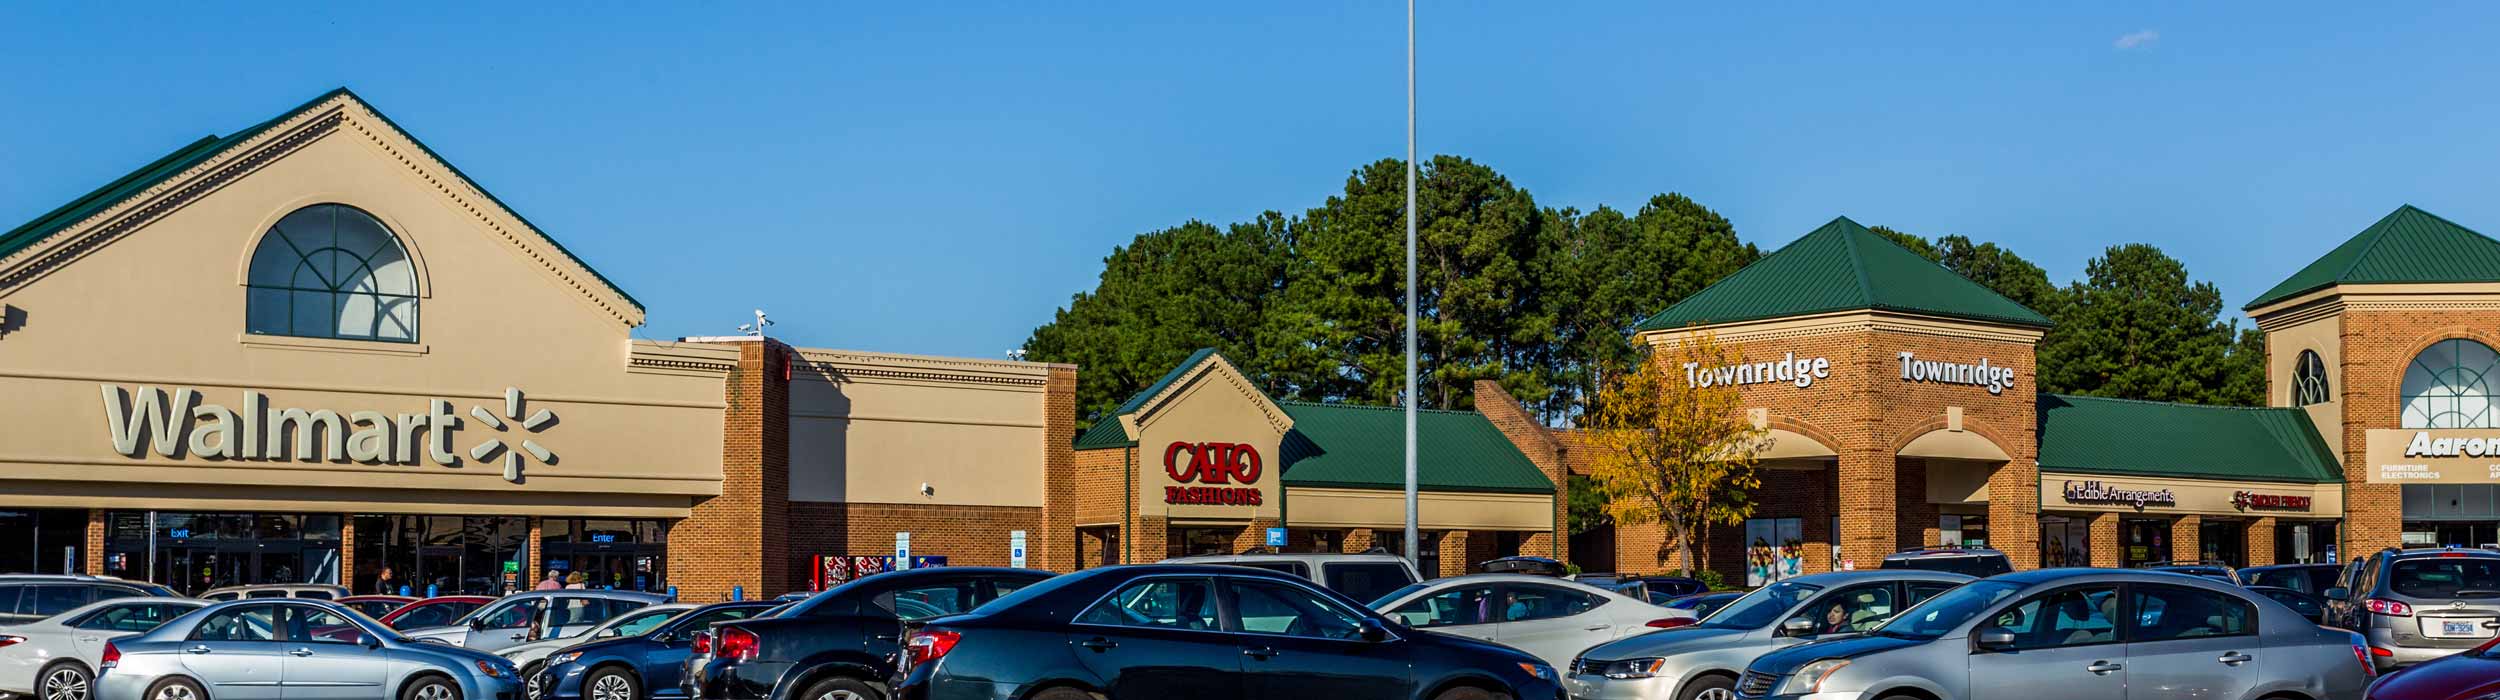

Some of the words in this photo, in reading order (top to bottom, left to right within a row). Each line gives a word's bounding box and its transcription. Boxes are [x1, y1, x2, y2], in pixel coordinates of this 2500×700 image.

[1683, 351, 1830, 388] Townridge
[1897, 352, 2015, 394] Townridge
[100, 383, 455, 464] Walmart
[1164, 441, 1262, 485] CATO
[2381, 464, 2429, 472] FURNITURE
[2381, 471, 2440, 480] ELECTRONICS
[1164, 486, 1262, 506] FASHIONS
[2077, 481, 2108, 500] Edible
[2109, 487, 2175, 507] Arrangements
[170, 528, 190, 538] Exit
[592, 533, 615, 543] Enter
